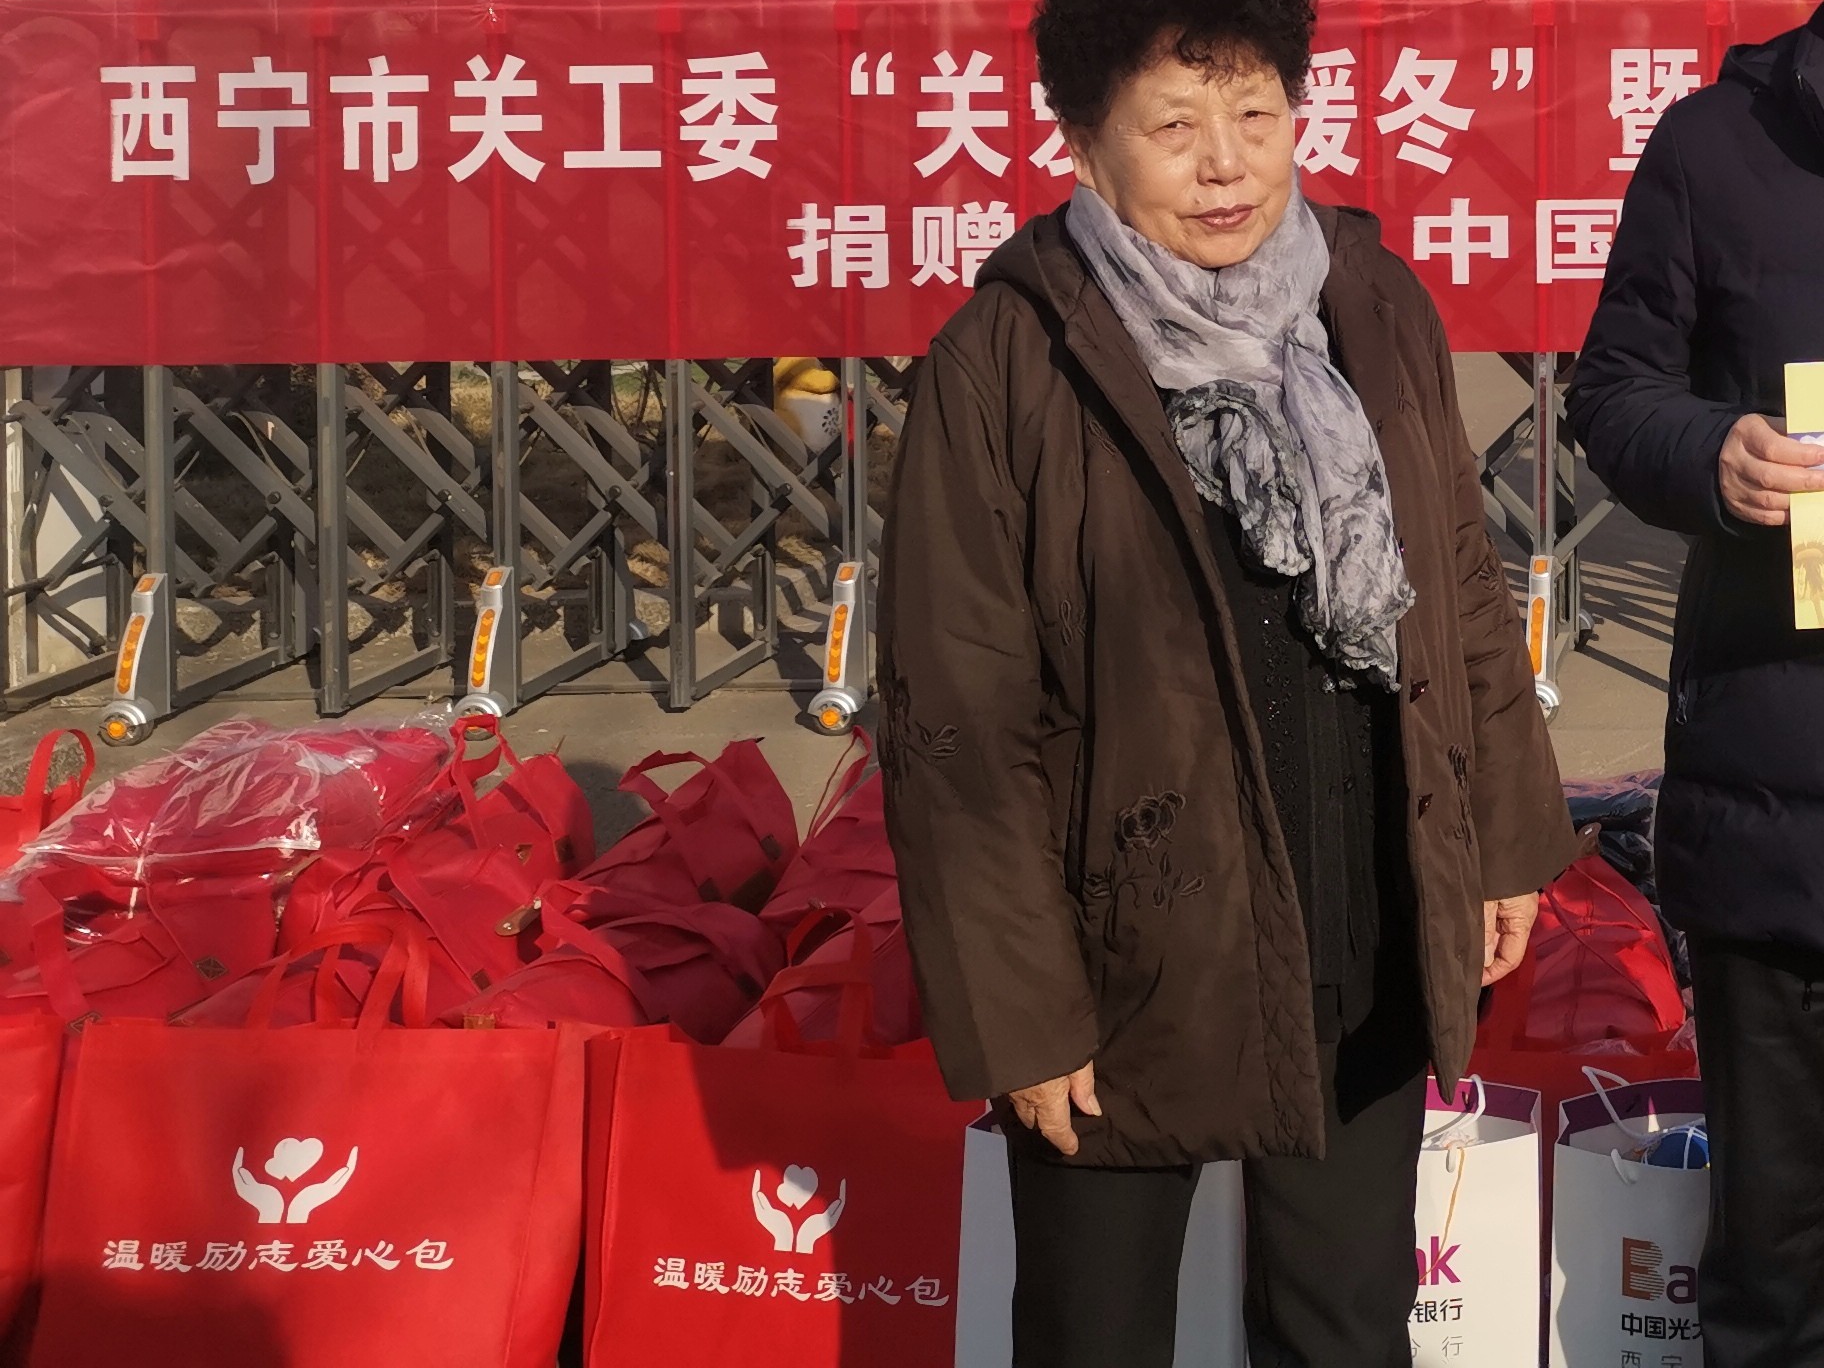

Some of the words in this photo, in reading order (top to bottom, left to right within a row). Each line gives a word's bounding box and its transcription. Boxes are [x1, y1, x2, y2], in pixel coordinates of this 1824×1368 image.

[786, 200, 1017, 289] 捐赠
[1412, 197, 1625, 286] 中国
[101, 1238, 454, 1272] 温暖励志爱心包
[652, 1256, 951, 1306] 温暖励志爱心包
[1406, 1297, 1464, 1324] 银行
